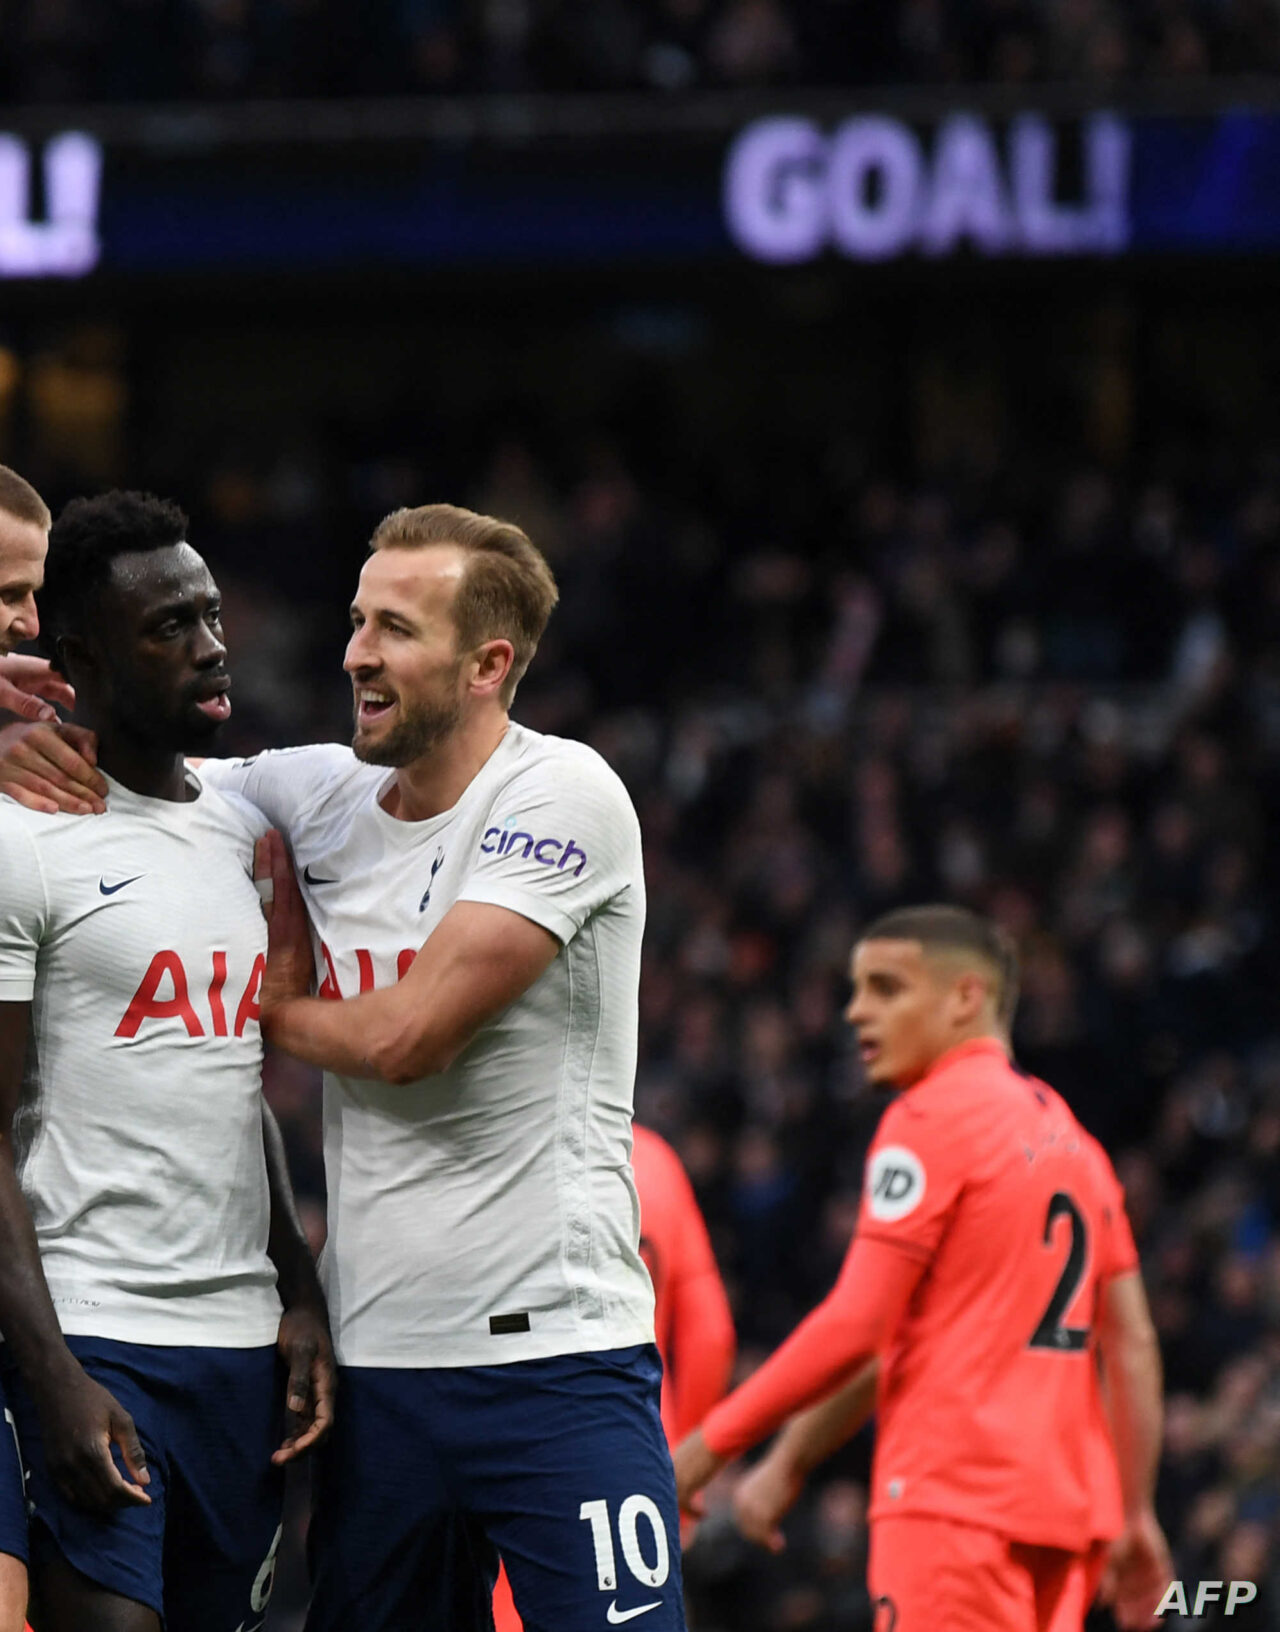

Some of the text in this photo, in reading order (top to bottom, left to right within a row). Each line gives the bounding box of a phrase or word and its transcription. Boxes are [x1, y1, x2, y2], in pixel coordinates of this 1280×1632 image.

[724, 112, 1129, 264] GOAL!
[481, 815, 587, 877] cinch
[1029, 1191, 1089, 1350] 2
[579, 1493, 670, 1591] 10
